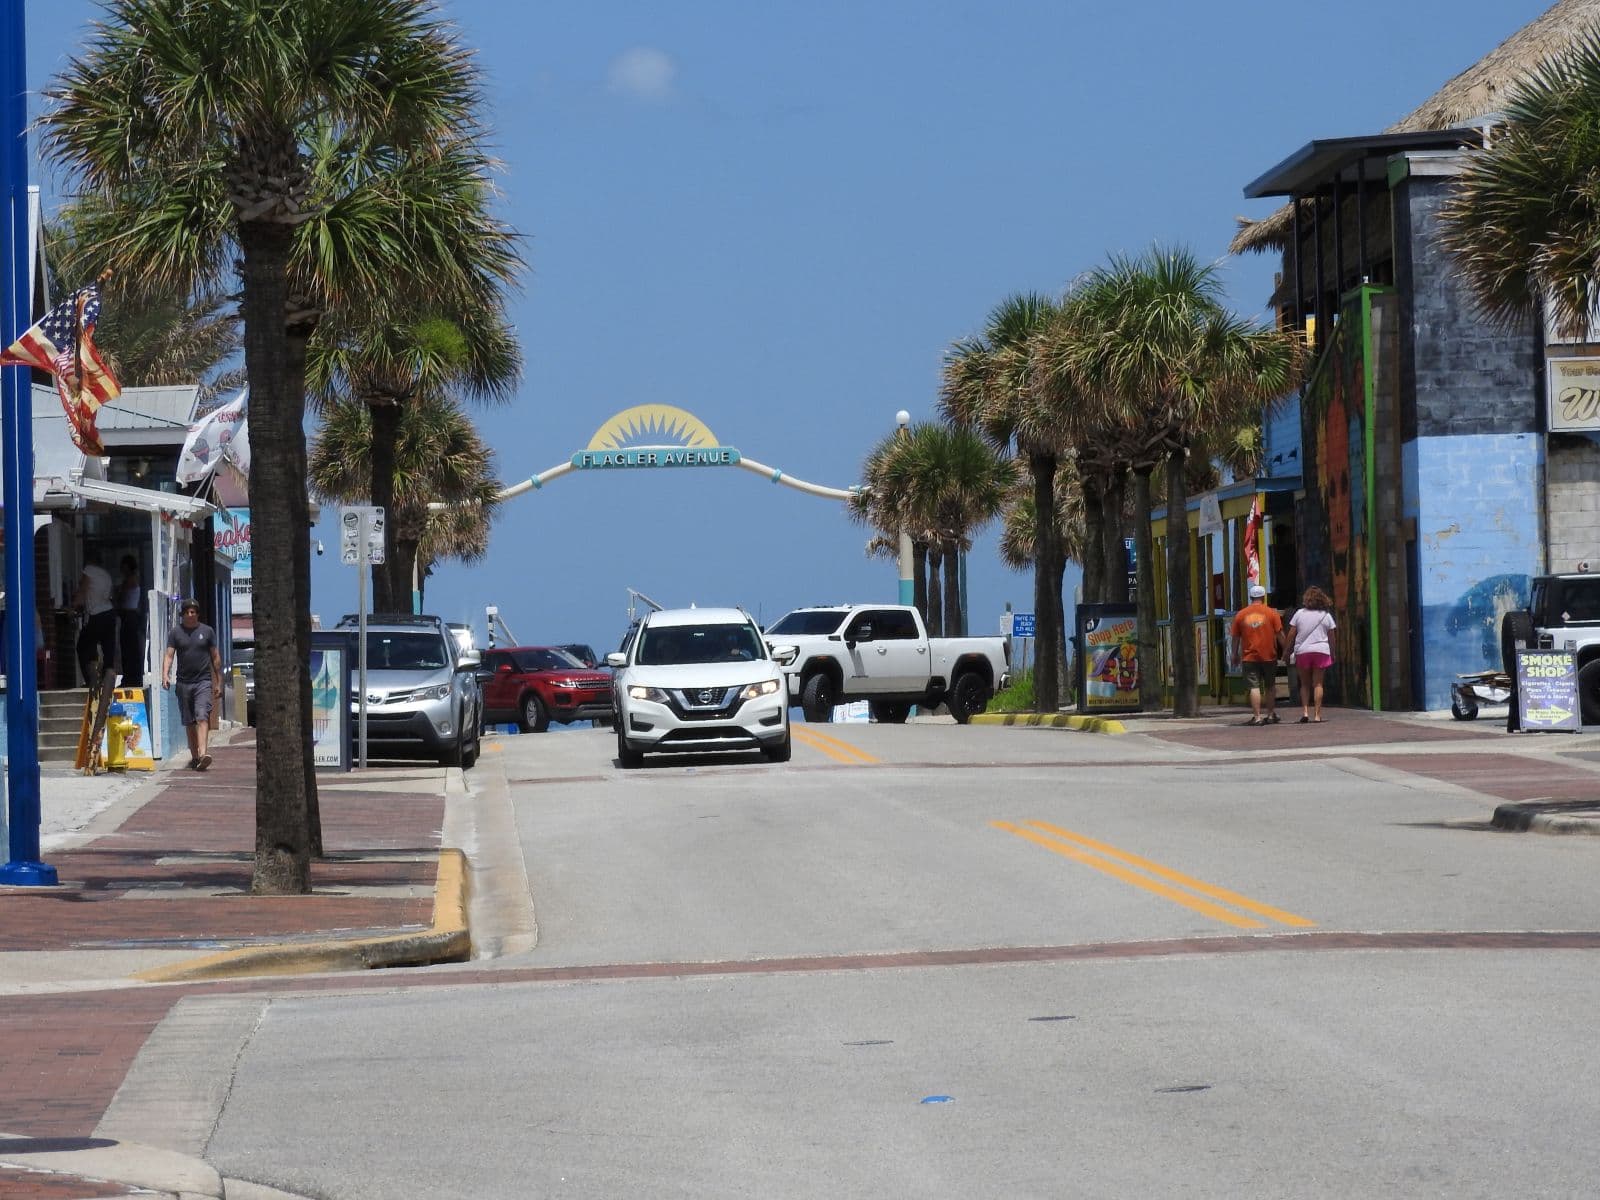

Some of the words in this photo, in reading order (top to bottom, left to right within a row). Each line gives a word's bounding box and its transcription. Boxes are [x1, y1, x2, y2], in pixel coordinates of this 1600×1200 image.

[582, 453, 657, 466] FLAGLER
[665, 451, 730, 464] AVENUE
[213, 514, 251, 548] eake
[232, 586, 252, 594] COOKS
[1088, 631, 1112, 646] Shop
[1111, 619, 1136, 636] Here
[1520, 655, 1573, 666] SMOKE
[1526, 666, 1567, 677] SHOP
[315, 755, 339, 763] LER.COM
